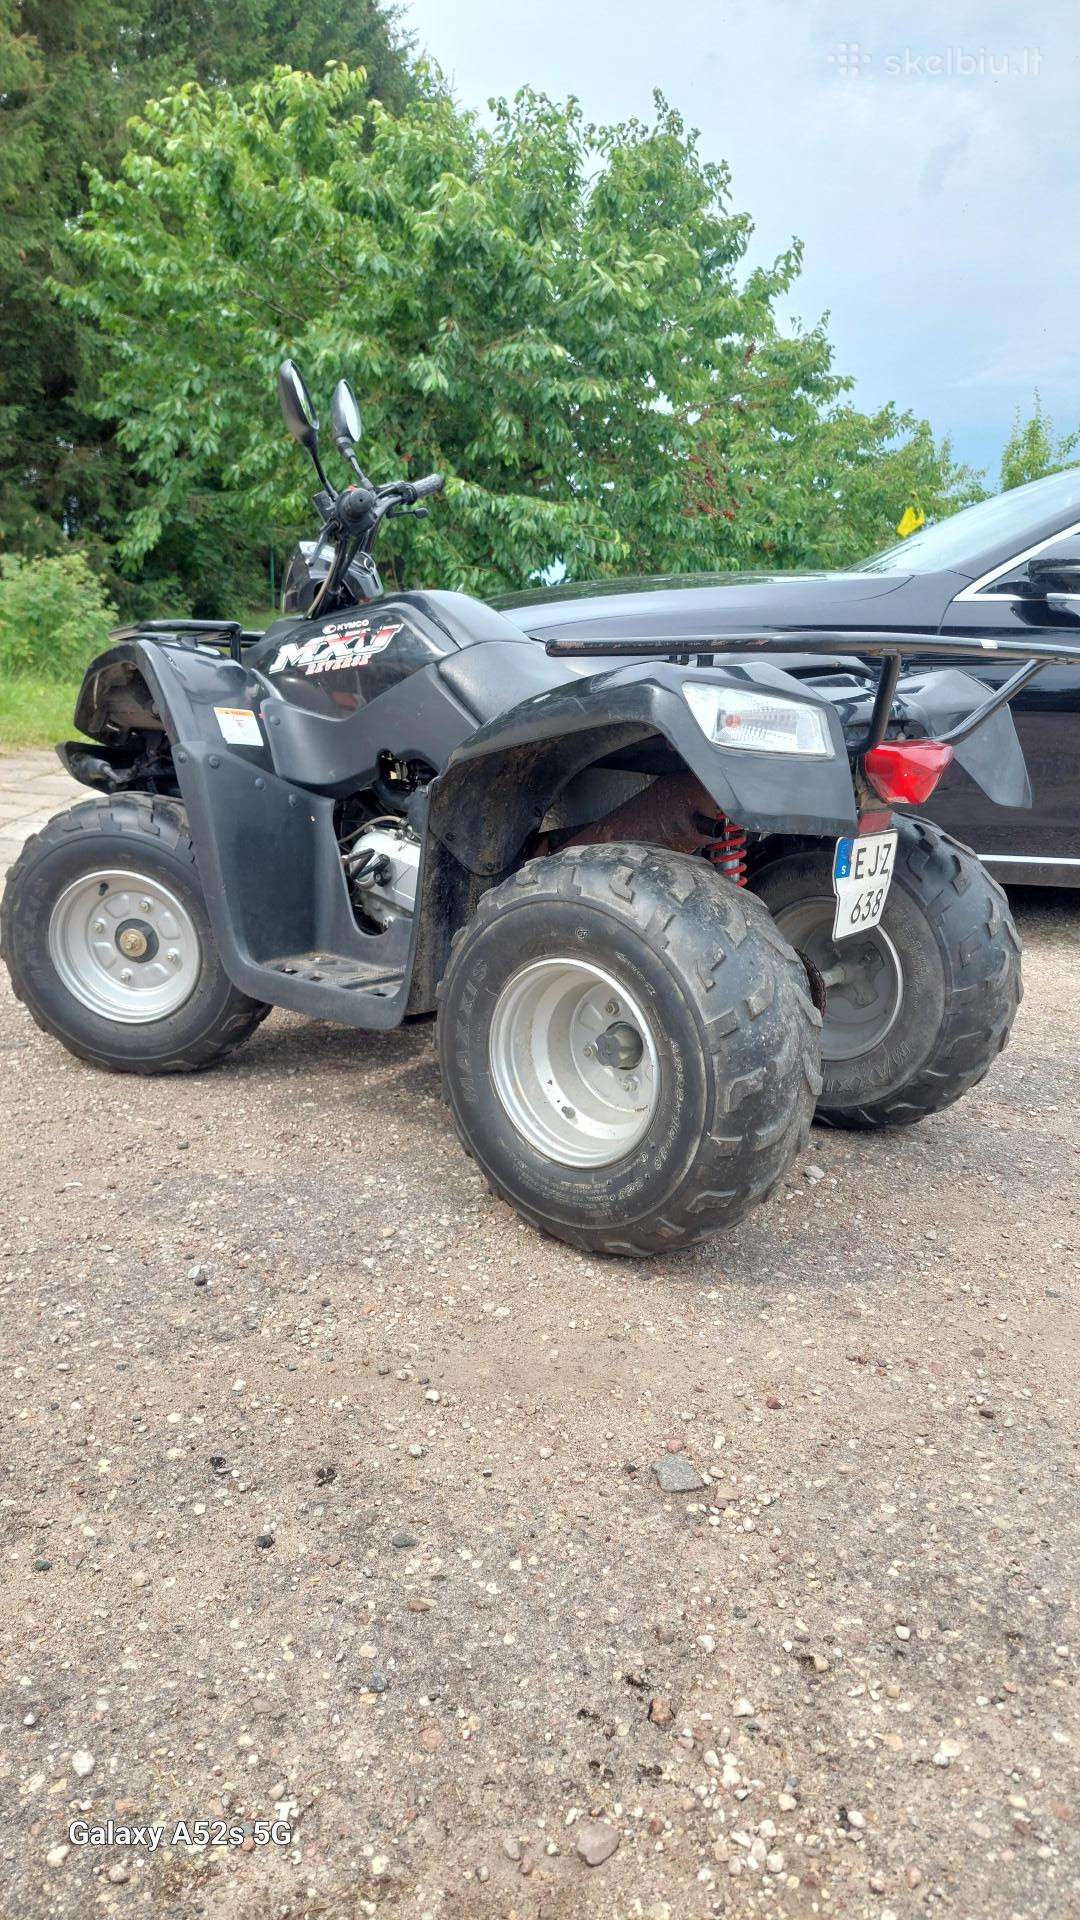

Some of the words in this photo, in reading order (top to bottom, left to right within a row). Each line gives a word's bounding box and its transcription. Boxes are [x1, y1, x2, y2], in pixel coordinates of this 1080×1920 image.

[336, 619, 370, 631] KYMCO
[269, 624, 405, 674] MXU
[841, 865, 847, 875] S
[855, 843, 892, 880] EJZ
[851, 888, 884, 924] 638
